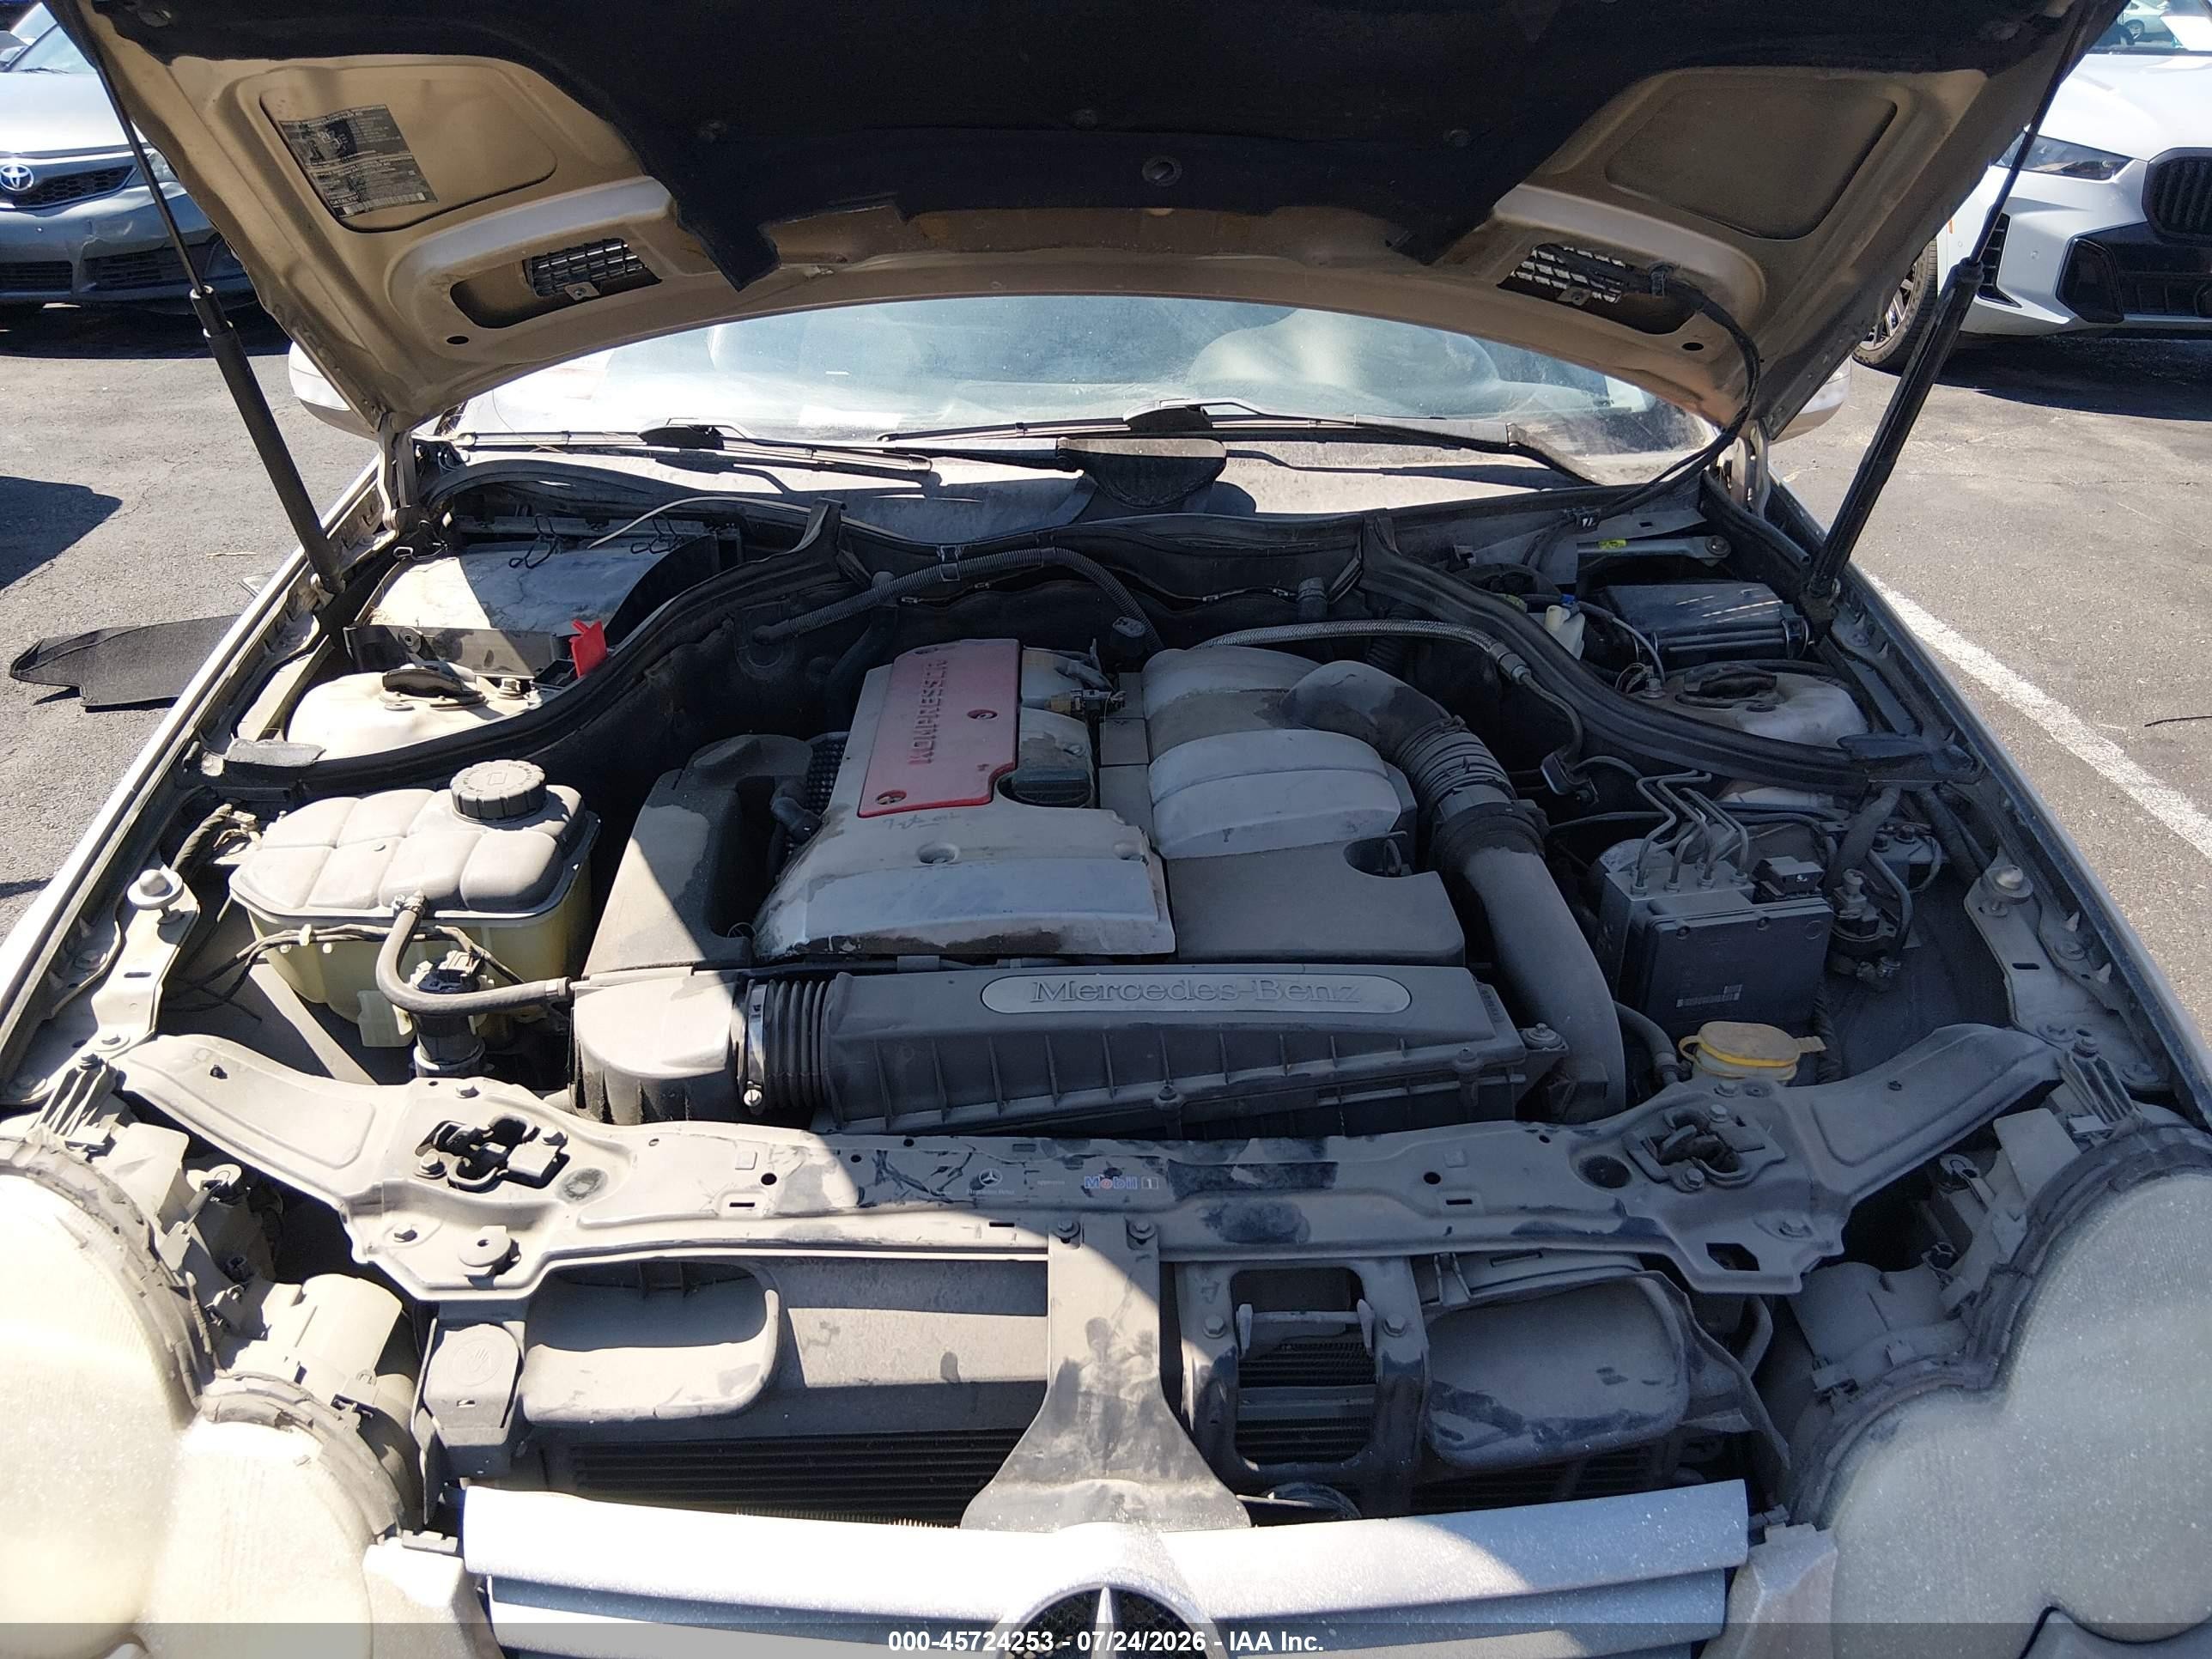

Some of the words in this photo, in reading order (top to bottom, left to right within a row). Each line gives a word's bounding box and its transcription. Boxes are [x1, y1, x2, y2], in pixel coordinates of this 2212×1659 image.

[907, 659, 948, 765] KOMPRESSOR
[1030, 978, 1361, 1004] Mercedes-Benz
[1084, 1174, 1139, 1190] Mobil
